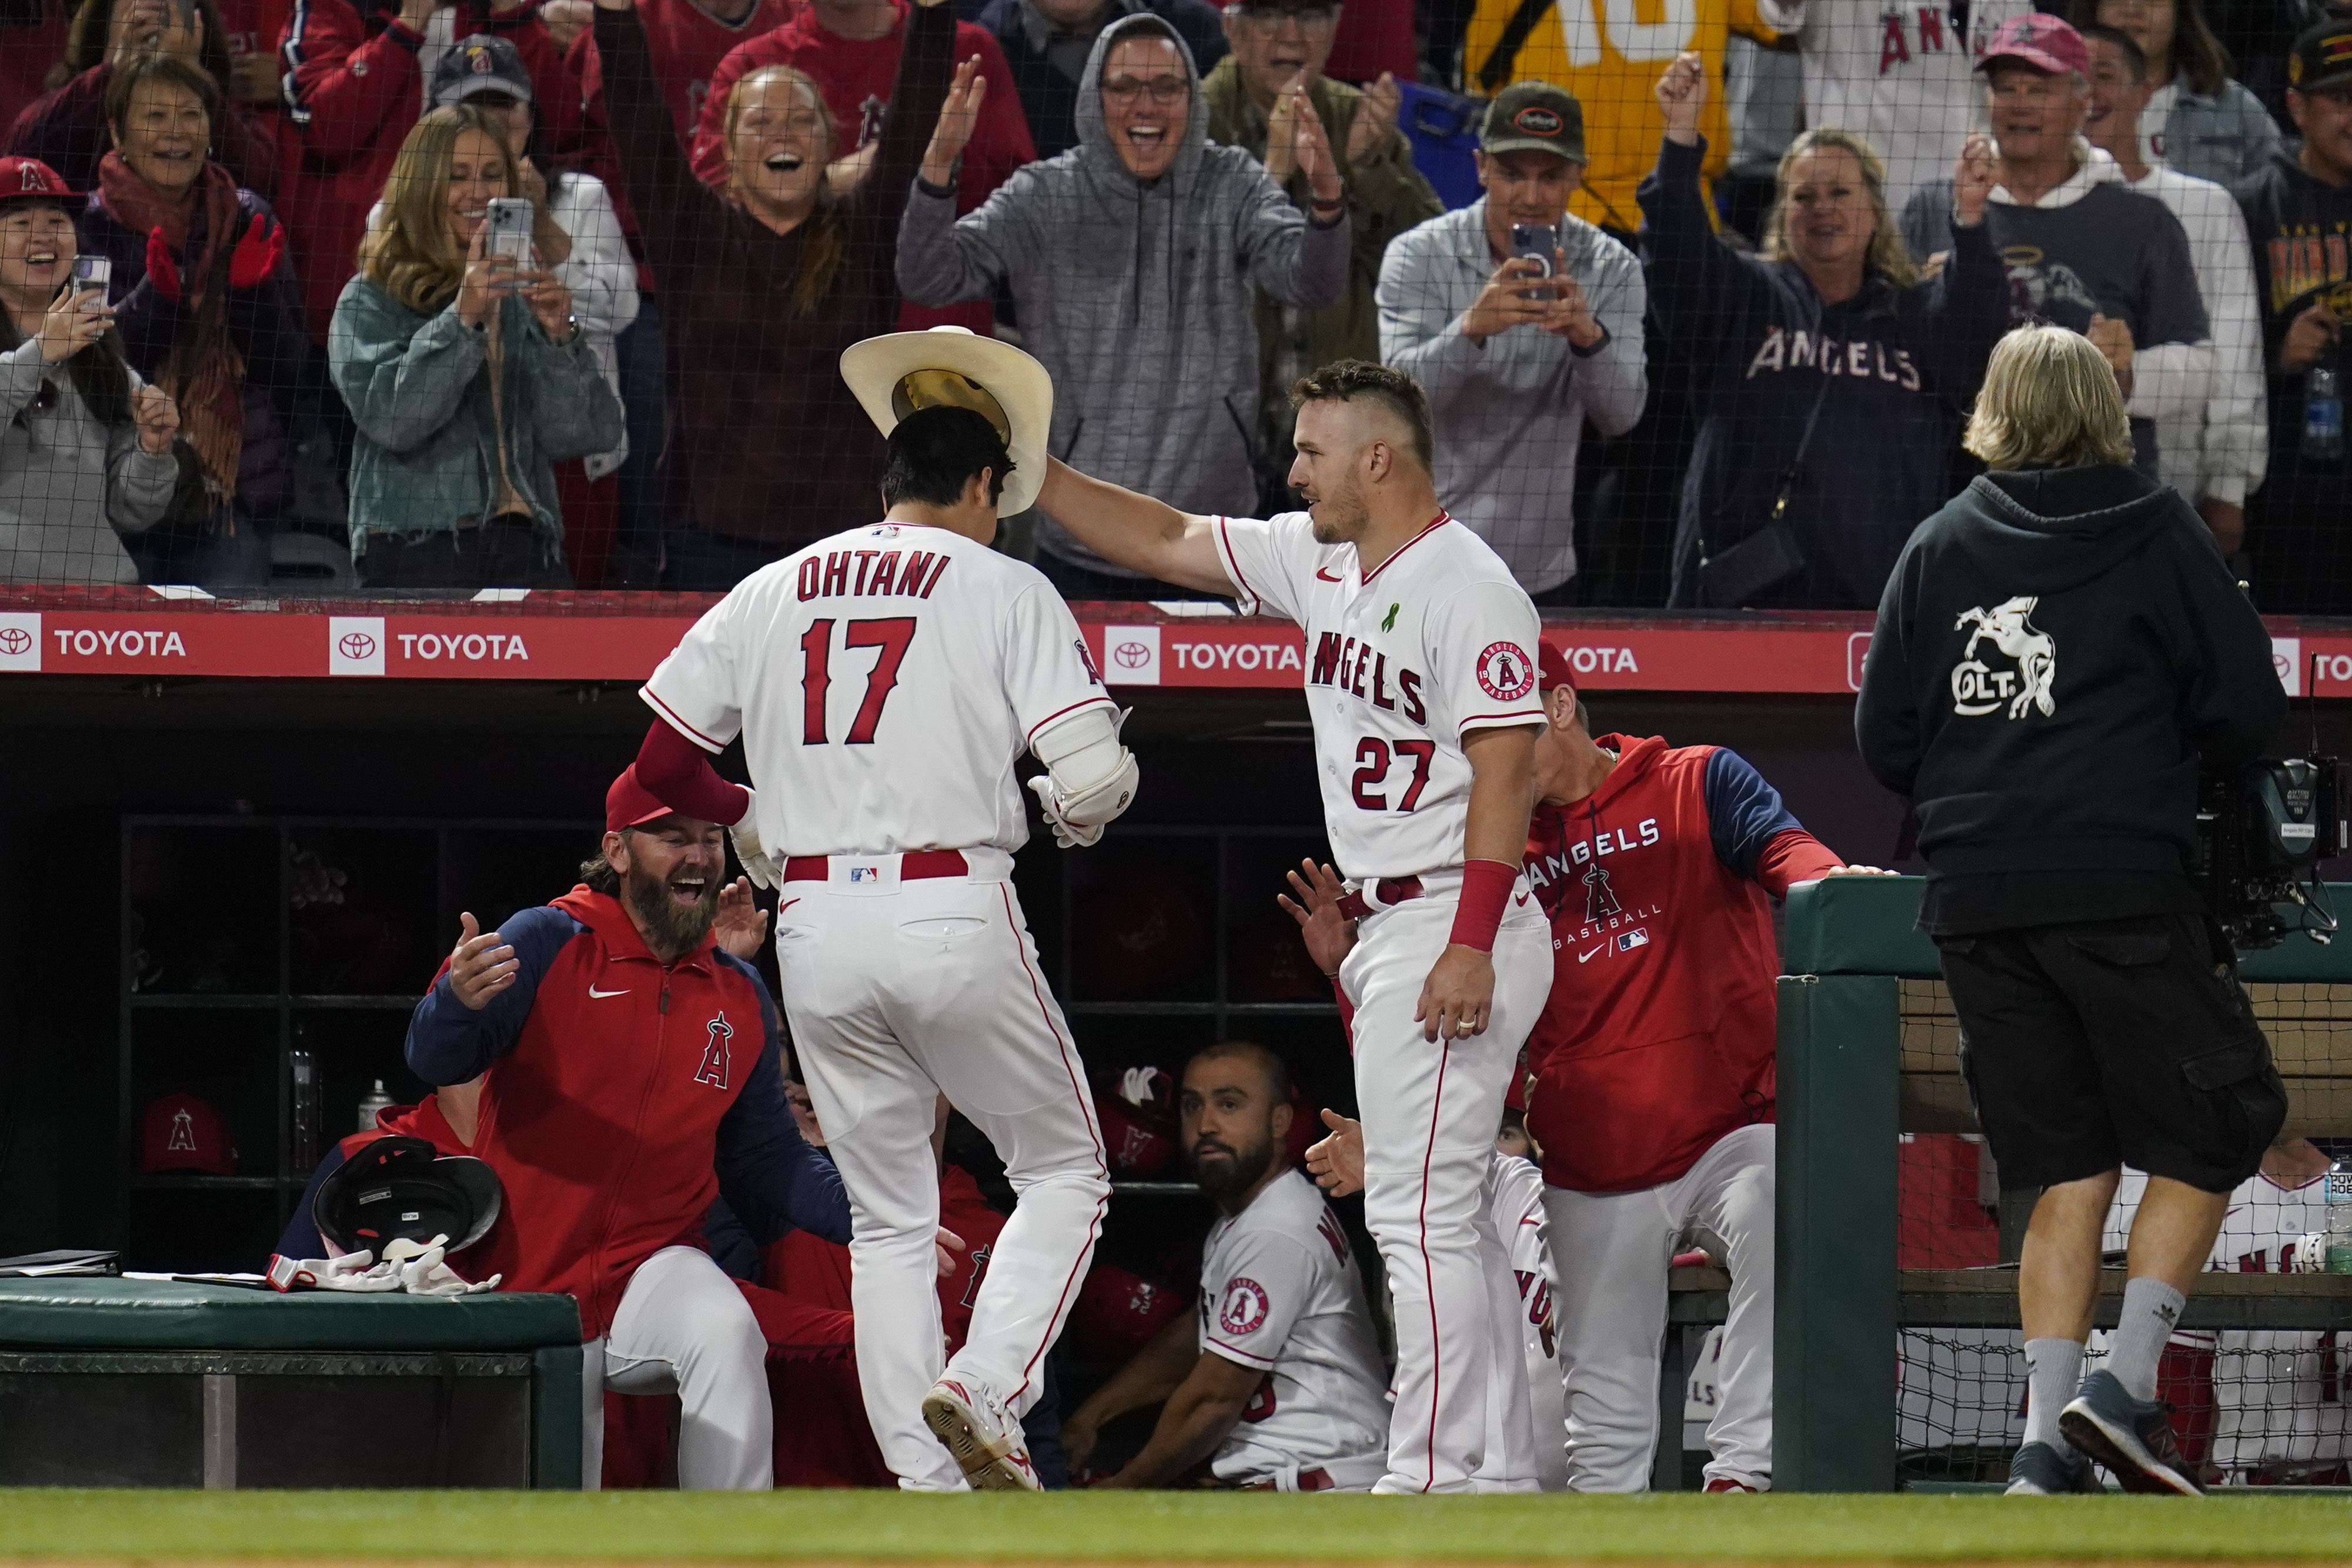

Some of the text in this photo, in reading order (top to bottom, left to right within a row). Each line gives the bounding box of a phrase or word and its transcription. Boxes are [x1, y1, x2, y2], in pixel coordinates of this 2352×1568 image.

[1746, 326, 1920, 392] ANGELS
[797, 550, 951, 603] OHTANI
[55, 630, 186, 657] TOYOTA
[398, 634, 529, 660] TOYOTA
[1172, 644, 1302, 670] TOYOTA
[1482, 643, 1522, 660] ANGELS
[800, 616, 917, 745] 17
[1311, 631, 1429, 727] NGELS
[1479, 670, 1489, 679] 19
[1482, 678, 1533, 700] BASEBALL
[1497, 652, 1519, 688] A
[1951, 658, 2015, 716] COLT
[1352, 737, 1436, 813] 27
[1529, 818, 1660, 892] ANGELS
[1553, 904, 1662, 950] BASEBALL
[694, 1011, 734, 1089] A
